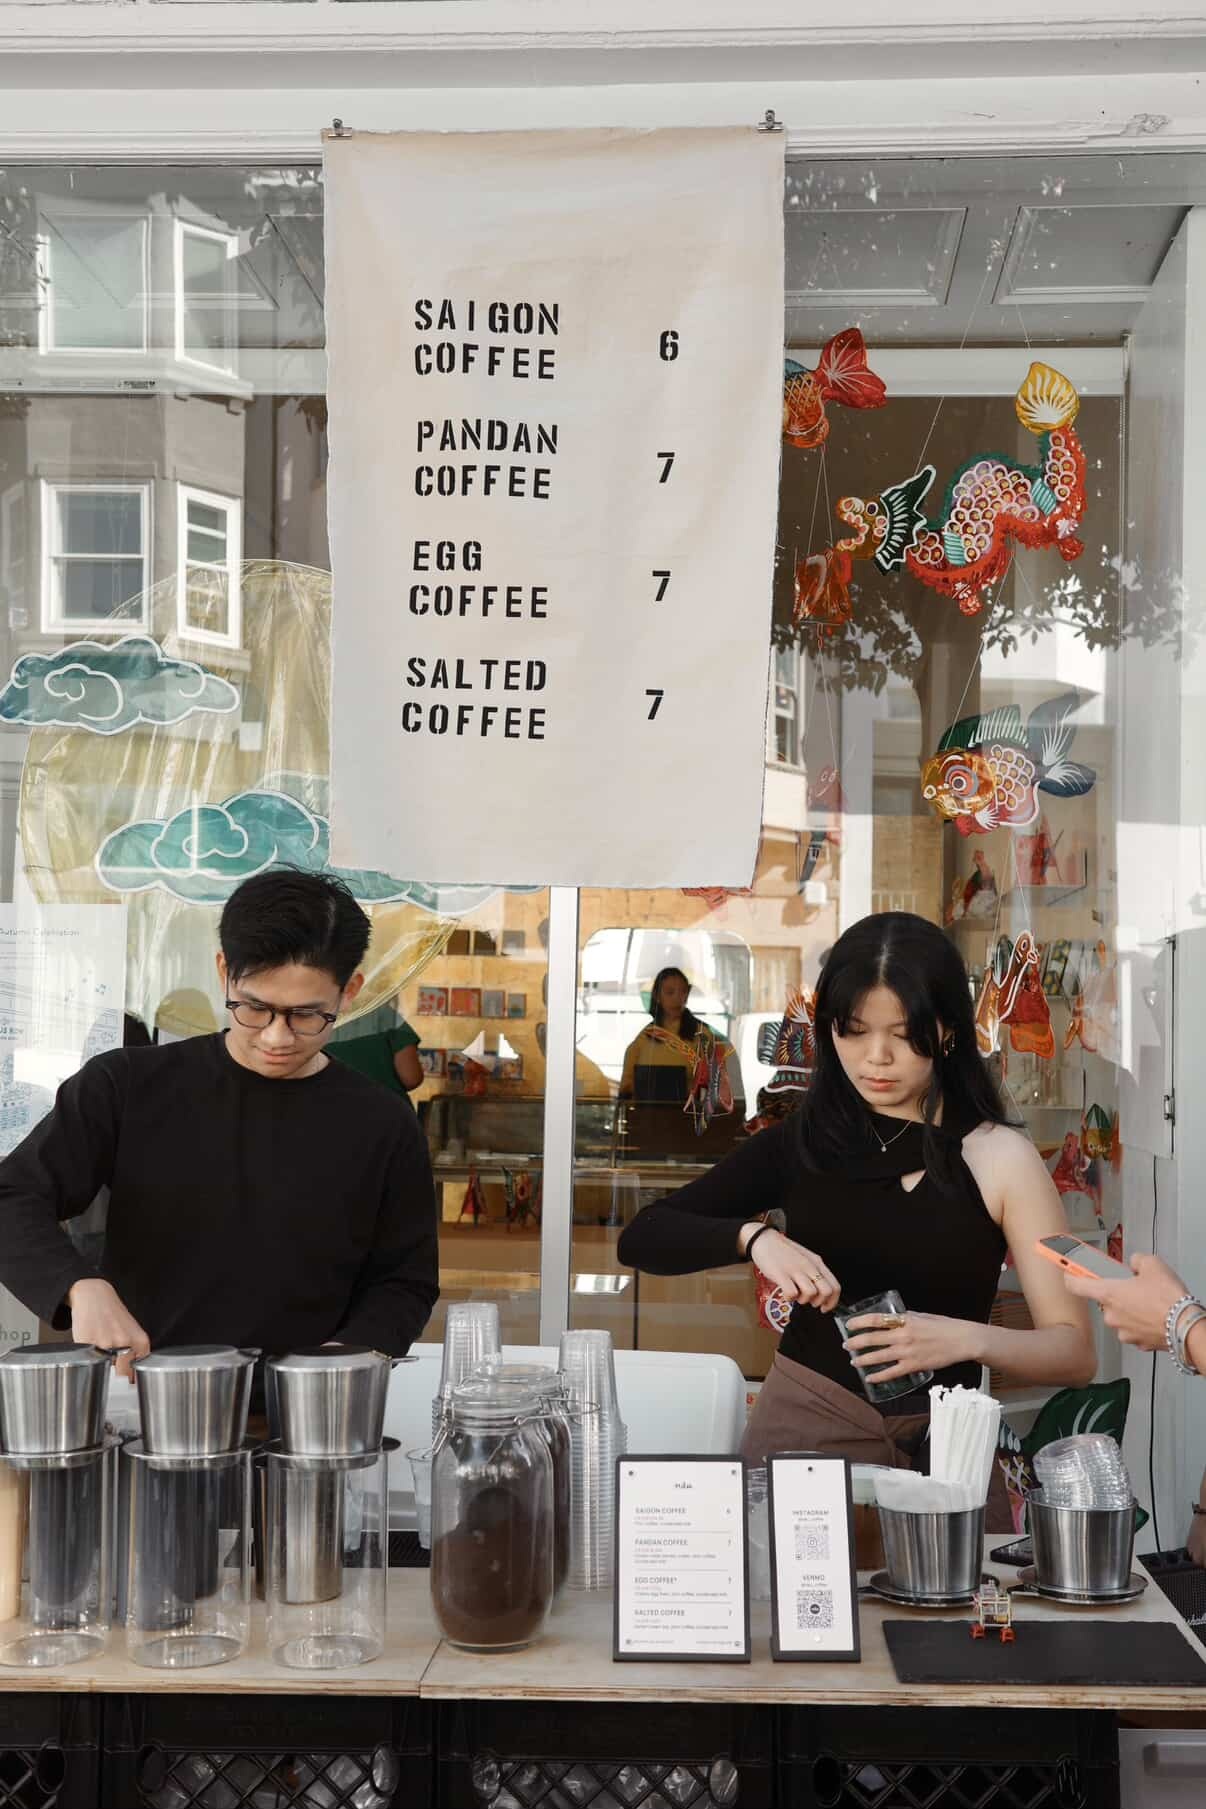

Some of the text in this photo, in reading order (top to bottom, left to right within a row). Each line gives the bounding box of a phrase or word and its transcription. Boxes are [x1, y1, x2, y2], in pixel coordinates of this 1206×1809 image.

[414, 299, 559, 336] SAIGON
[414, 342, 555, 380] COFFEE
[659, 330, 679, 362] 6
[416, 418, 558, 455] PANDAN
[414, 464, 551, 500] COFFEE
[657, 451, 675, 484] 7
[413, 540, 482, 572] EGG
[409, 584, 548, 619] COFFEE
[652, 570, 671, 602] 7
[406, 657, 547, 692] SALTED
[401, 702, 546, 740] COFFEE
[645, 689, 664, 721] 7
[634, 1576, 649, 1584] EGG
